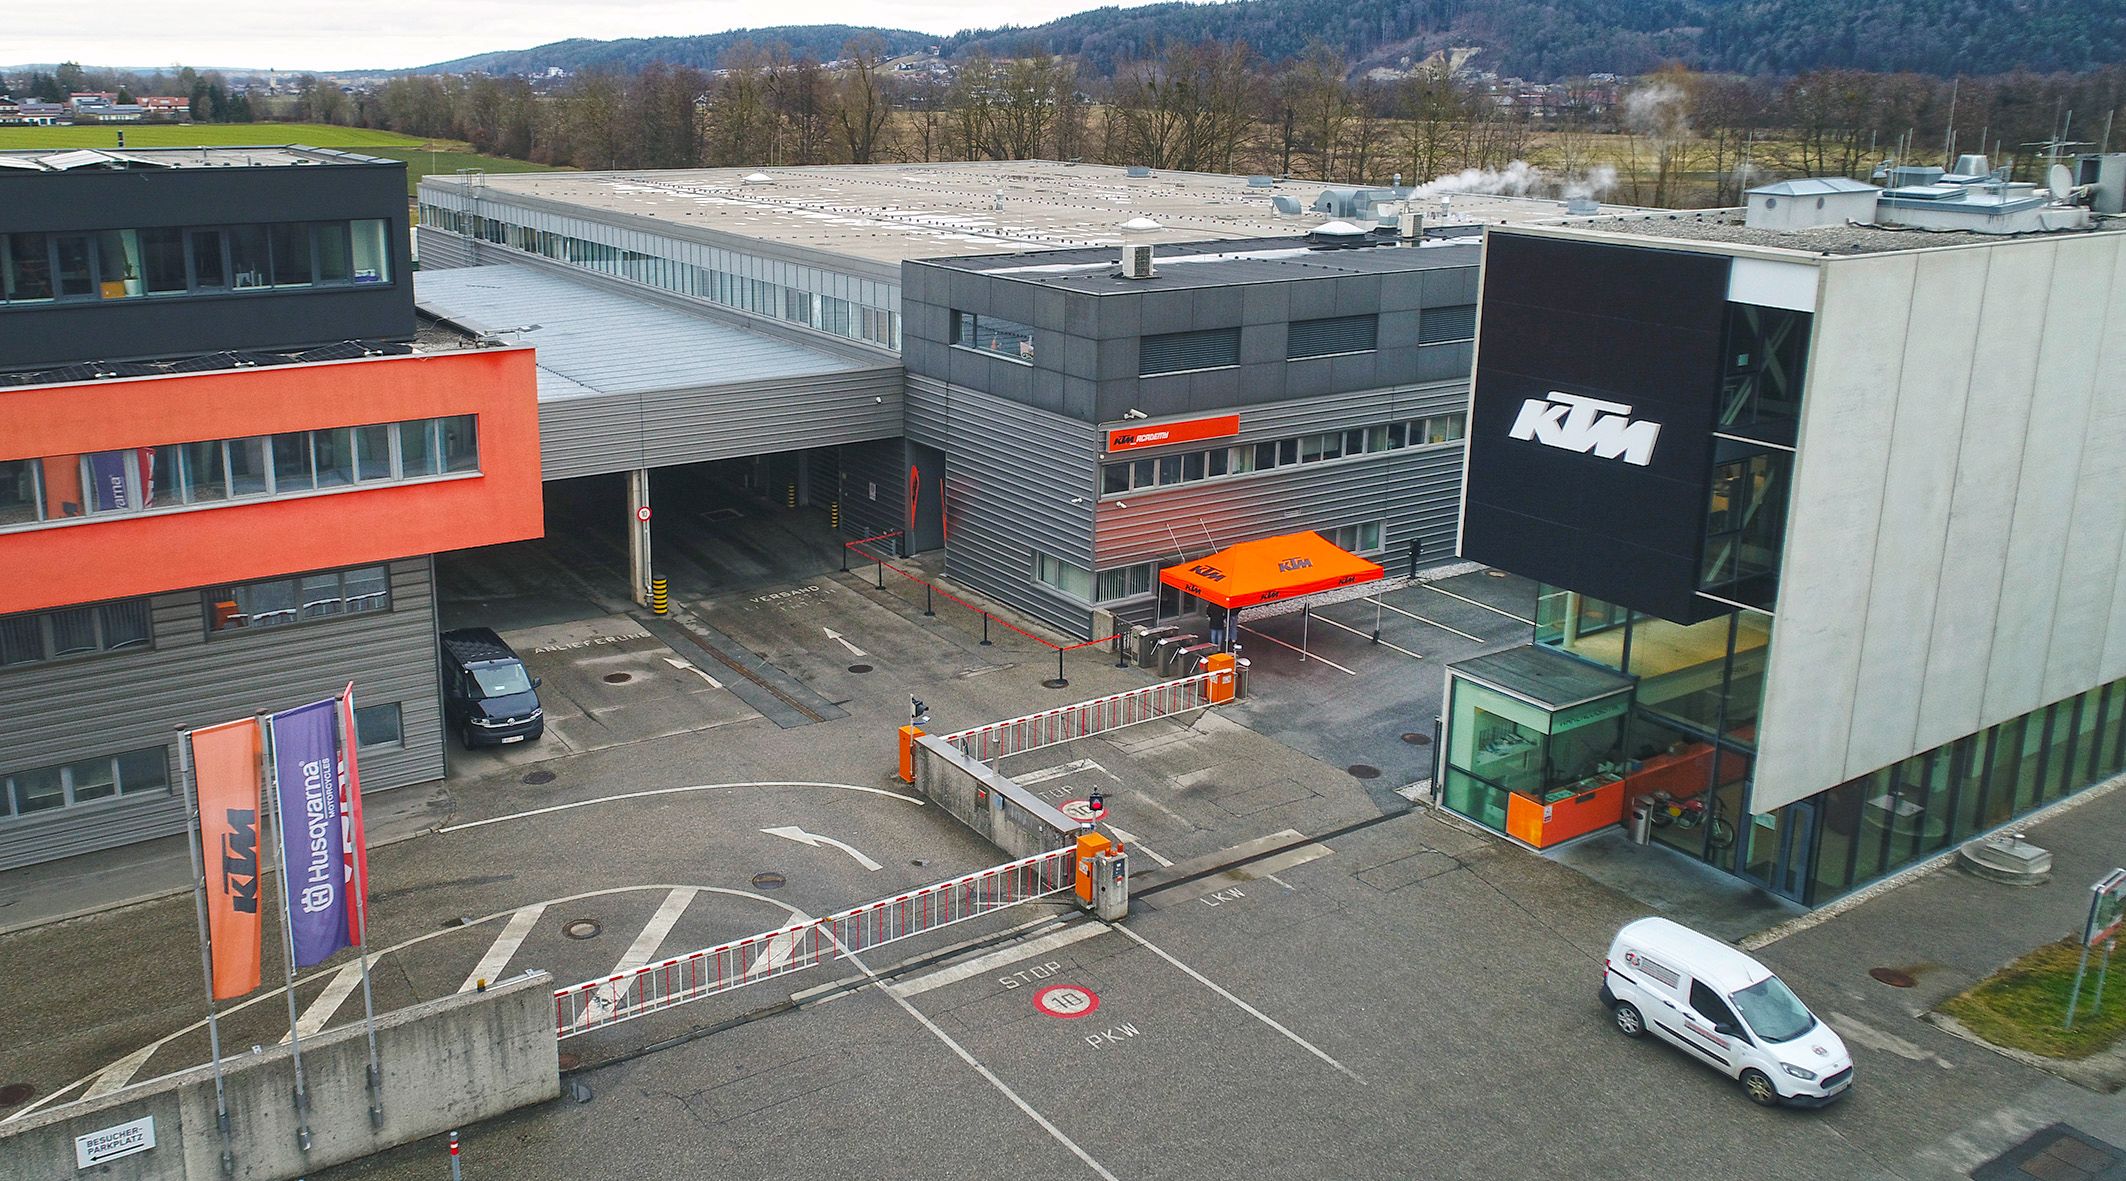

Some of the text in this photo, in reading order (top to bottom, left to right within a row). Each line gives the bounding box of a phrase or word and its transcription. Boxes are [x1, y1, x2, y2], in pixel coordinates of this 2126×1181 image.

[1508, 391, 1662, 466] KTM
[1189, 565, 1226, 582] KTM
[1278, 557, 1313, 573] KTM
[1185, 584, 1202, 594] KTM
[1338, 576, 1356, 585] KTM
[1261, 591, 1280, 600] KTM
[535, 631, 652, 654] ANLIEFERUNG
[323, 757, 336, 818] MOTORCYCLES
[1038, 784, 1075, 801] TOP
[302, 760, 330, 884] Husqvarna
[221, 808, 257, 914] KTM
[1200, 887, 1246, 907] LKW
[999, 961, 1061, 989] STOP
[1051, 993, 1083, 1009] 10
[1085, 1022, 1141, 1050] PKW
[86, 1126, 143, 1148] BESUCHER-
[87, 1133, 144, 1155] PARKPLATZ
